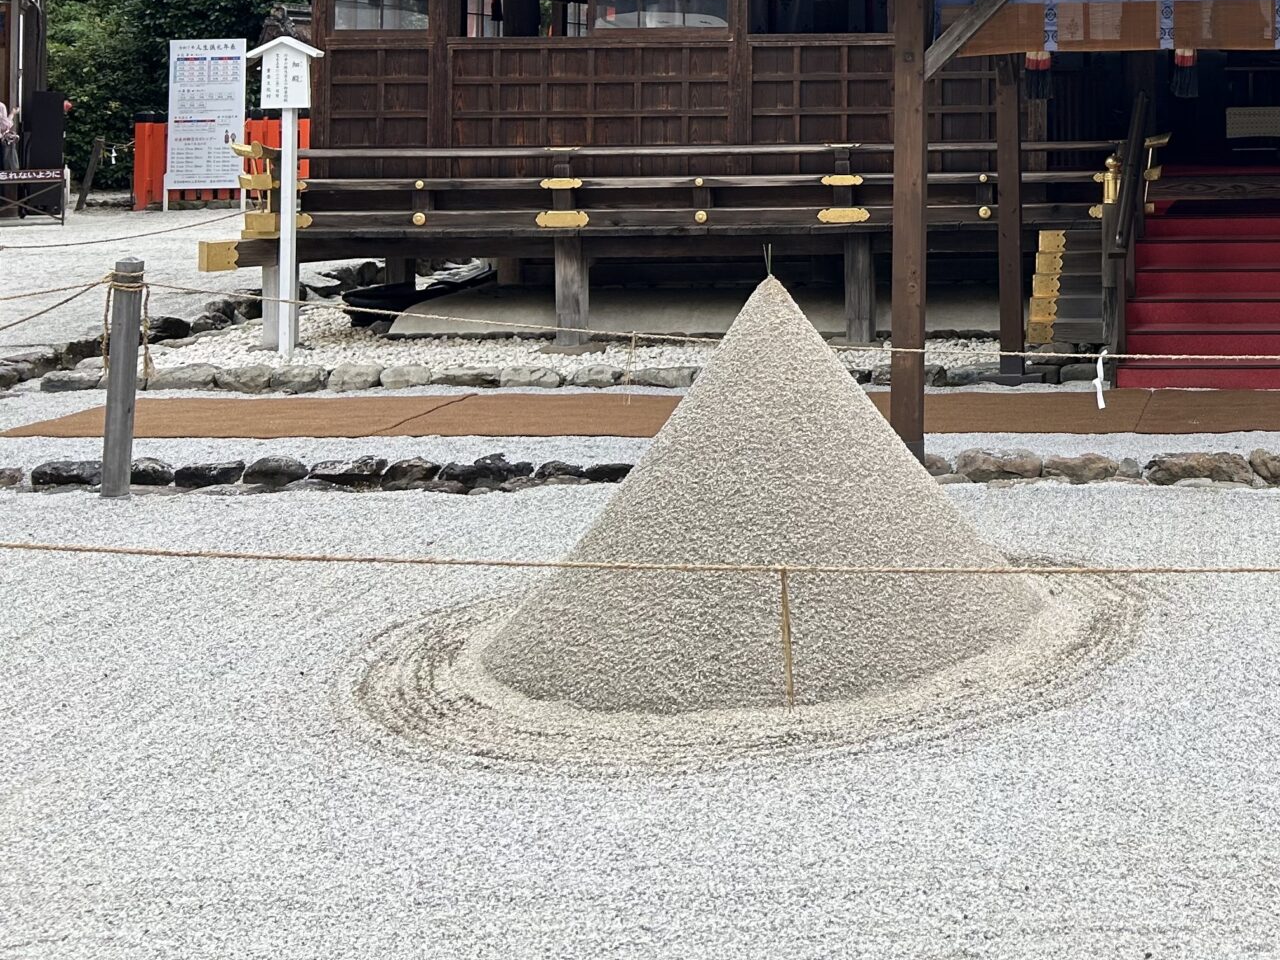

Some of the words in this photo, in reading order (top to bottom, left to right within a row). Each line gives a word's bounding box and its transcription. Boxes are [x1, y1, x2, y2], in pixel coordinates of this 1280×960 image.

[0, 170, 61, 180] 忘れないように
